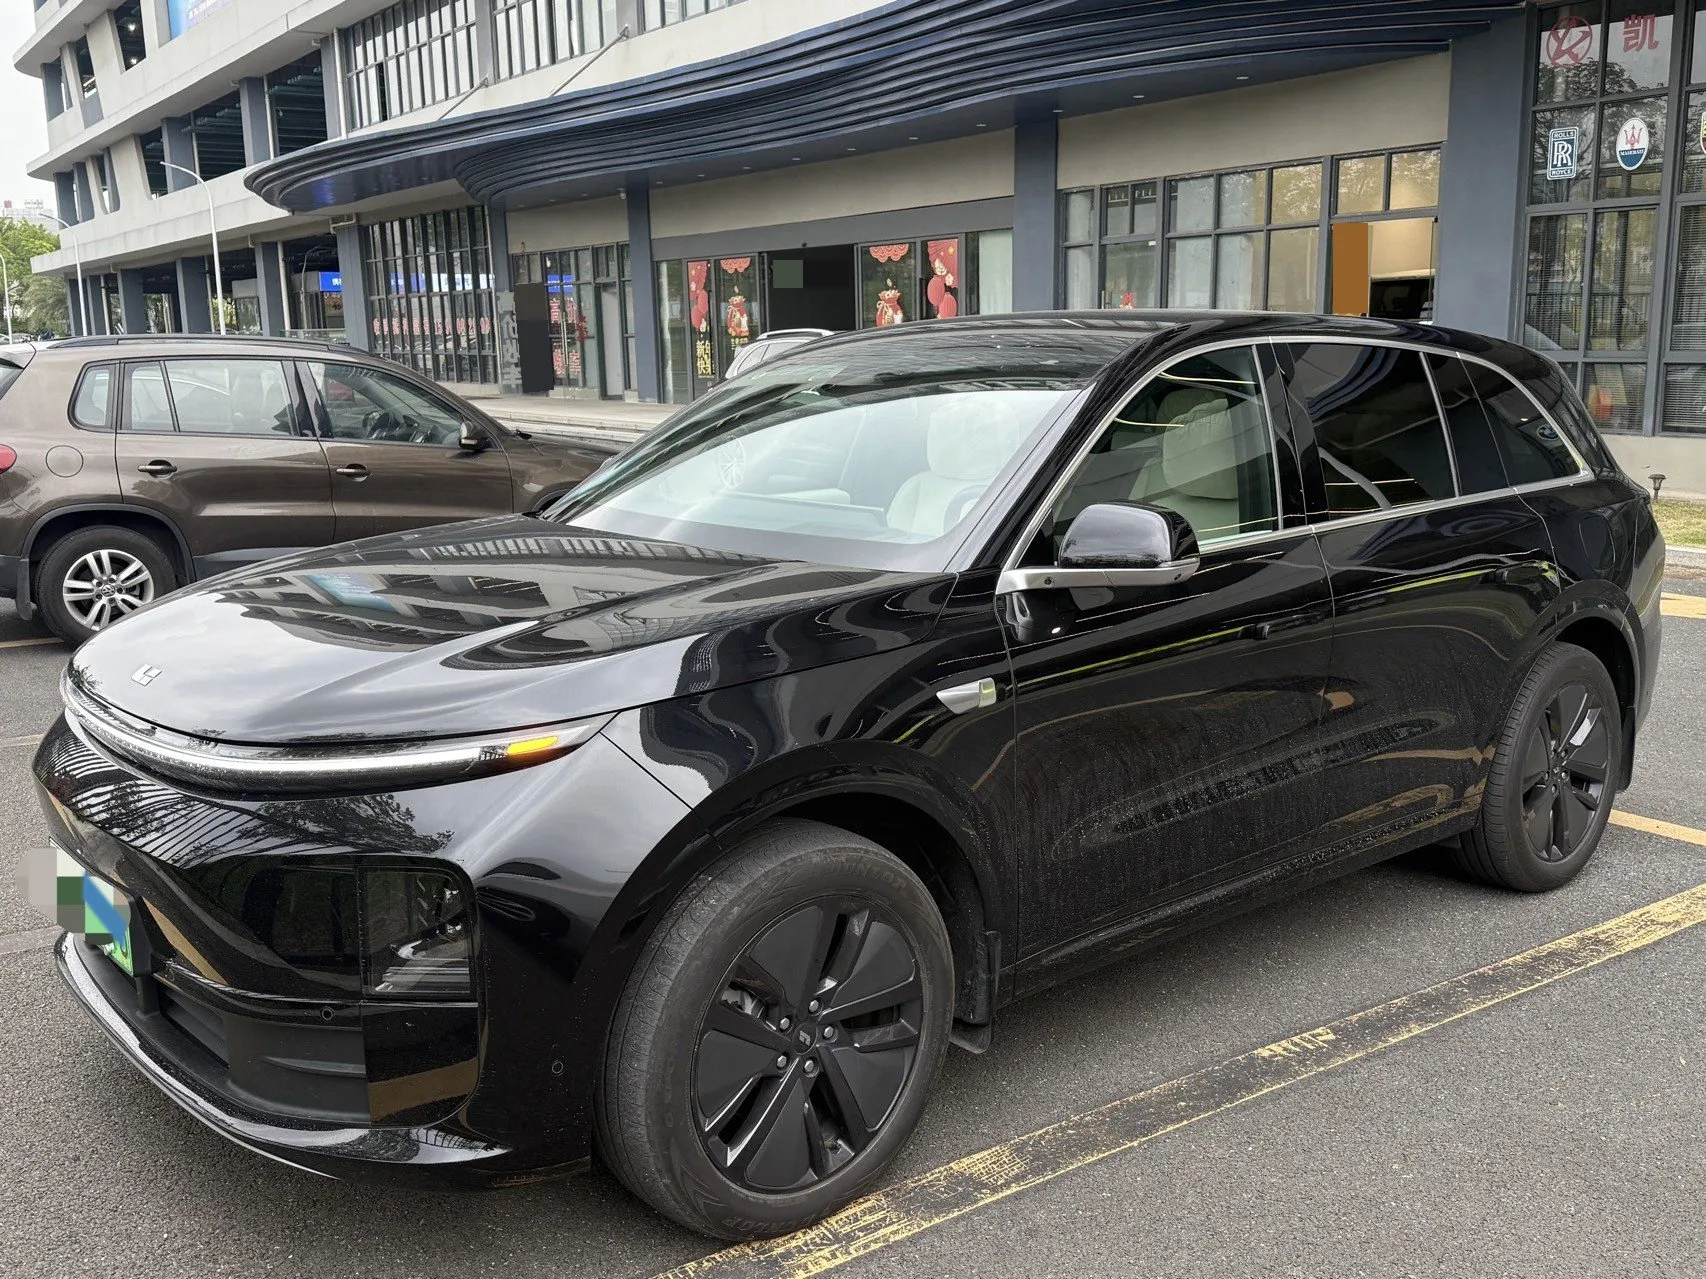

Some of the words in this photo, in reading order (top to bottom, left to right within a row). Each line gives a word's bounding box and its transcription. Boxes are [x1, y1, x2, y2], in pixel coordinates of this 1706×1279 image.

[1622, 13, 1660, 53] 凯
[1553, 131, 1574, 140] ROLLS
[1619, 149, 1645, 157] MASERATI
[1551, 168, 1572, 176] ROYCE
